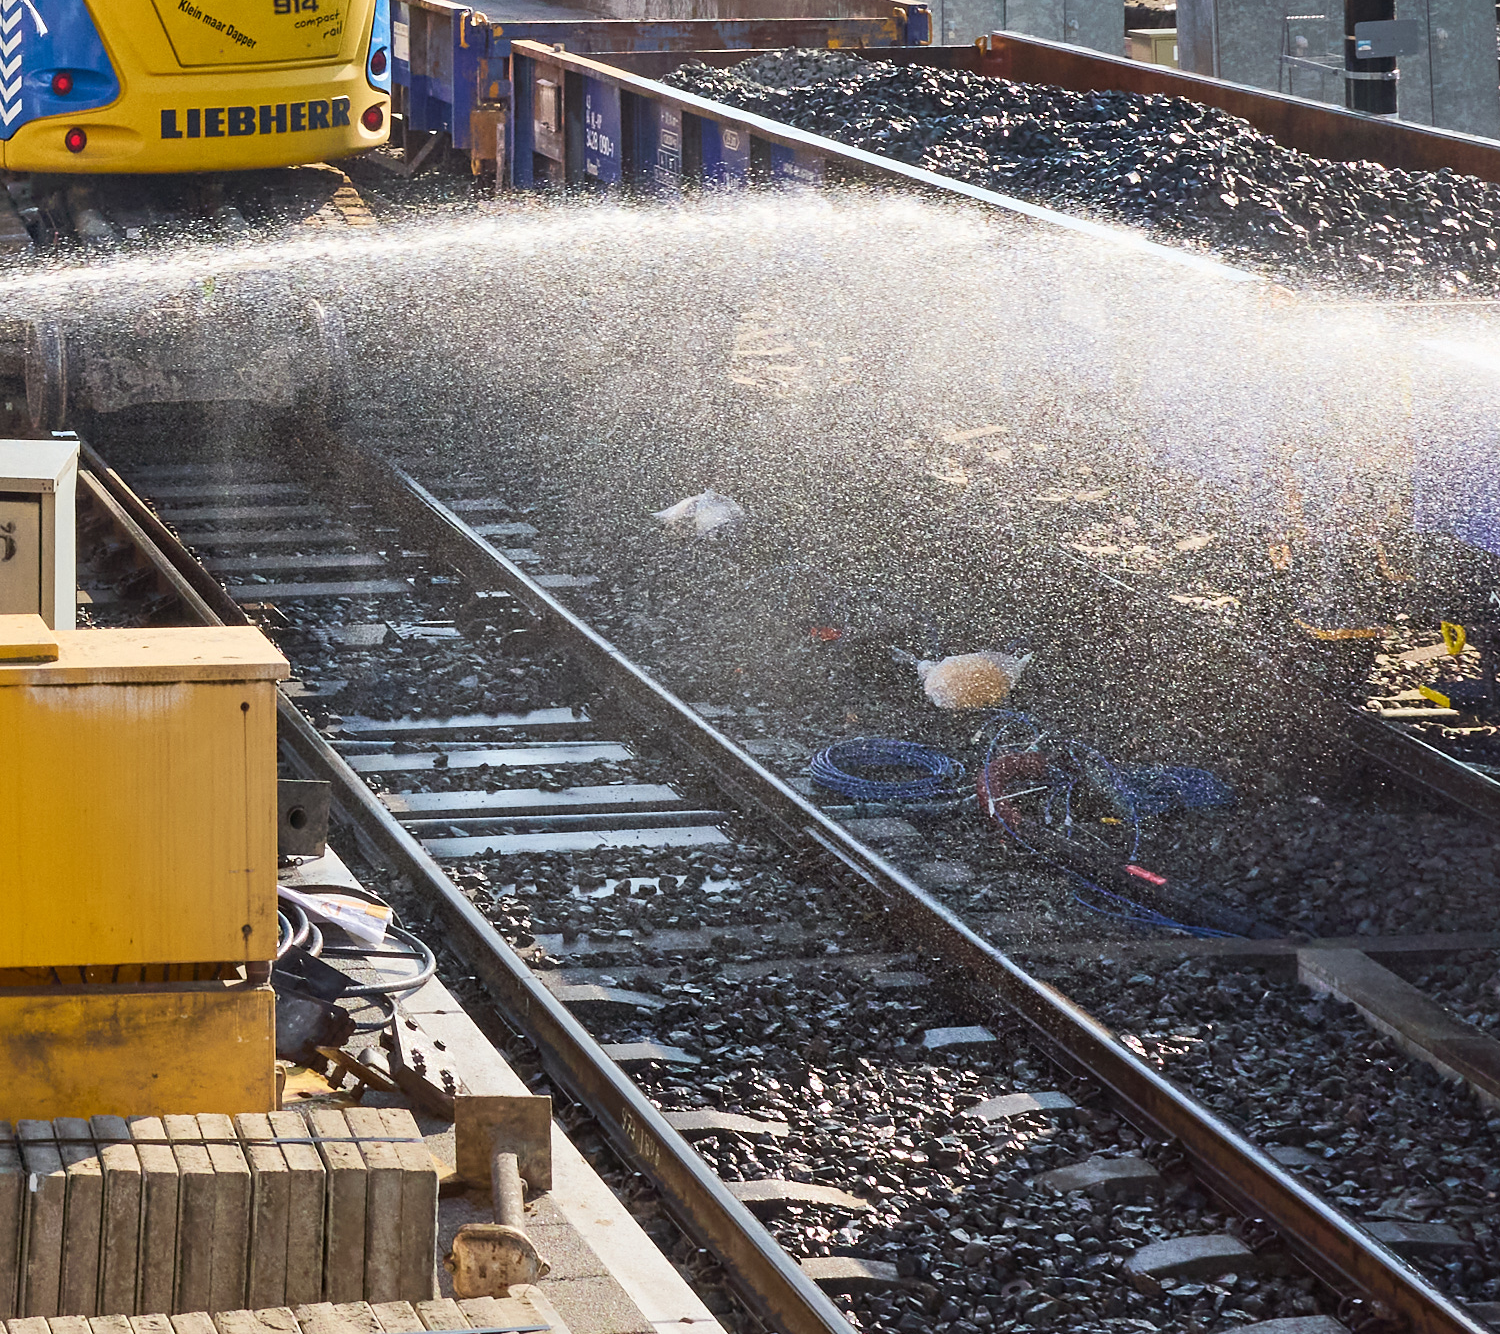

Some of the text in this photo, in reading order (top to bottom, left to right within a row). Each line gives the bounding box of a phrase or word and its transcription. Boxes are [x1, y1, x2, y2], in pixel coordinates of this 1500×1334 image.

[203, 14, 227, 32] maar
[226, 24, 257, 49] Dapper
[294, 10, 341, 29] compact
[323, 20, 343, 39] rail
[161, 97, 350, 139] LIEBHERR
